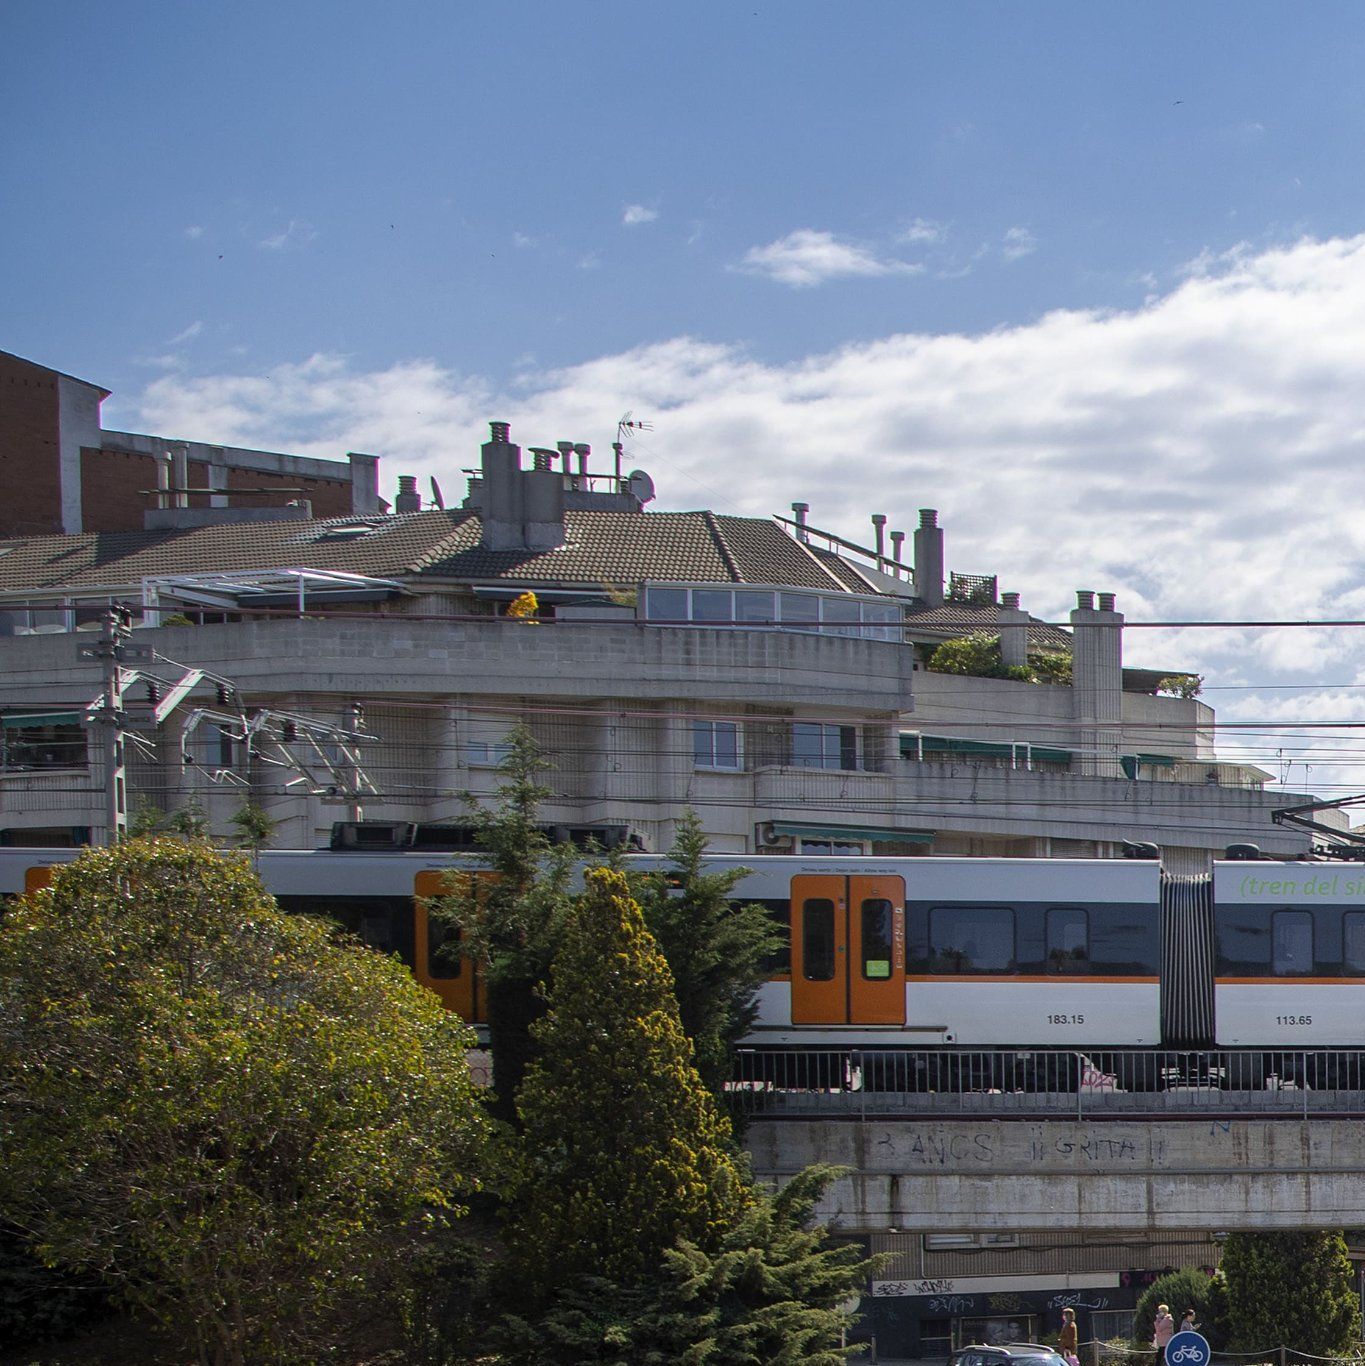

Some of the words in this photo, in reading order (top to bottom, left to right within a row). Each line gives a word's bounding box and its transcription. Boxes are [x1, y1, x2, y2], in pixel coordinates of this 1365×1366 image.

[1240, 876, 1297, 898] (tren
[1308, 875, 1336, 895] del
[1047, 1014, 1084, 1025] 183.15
[1276, 1015, 1312, 1025] 113.65
